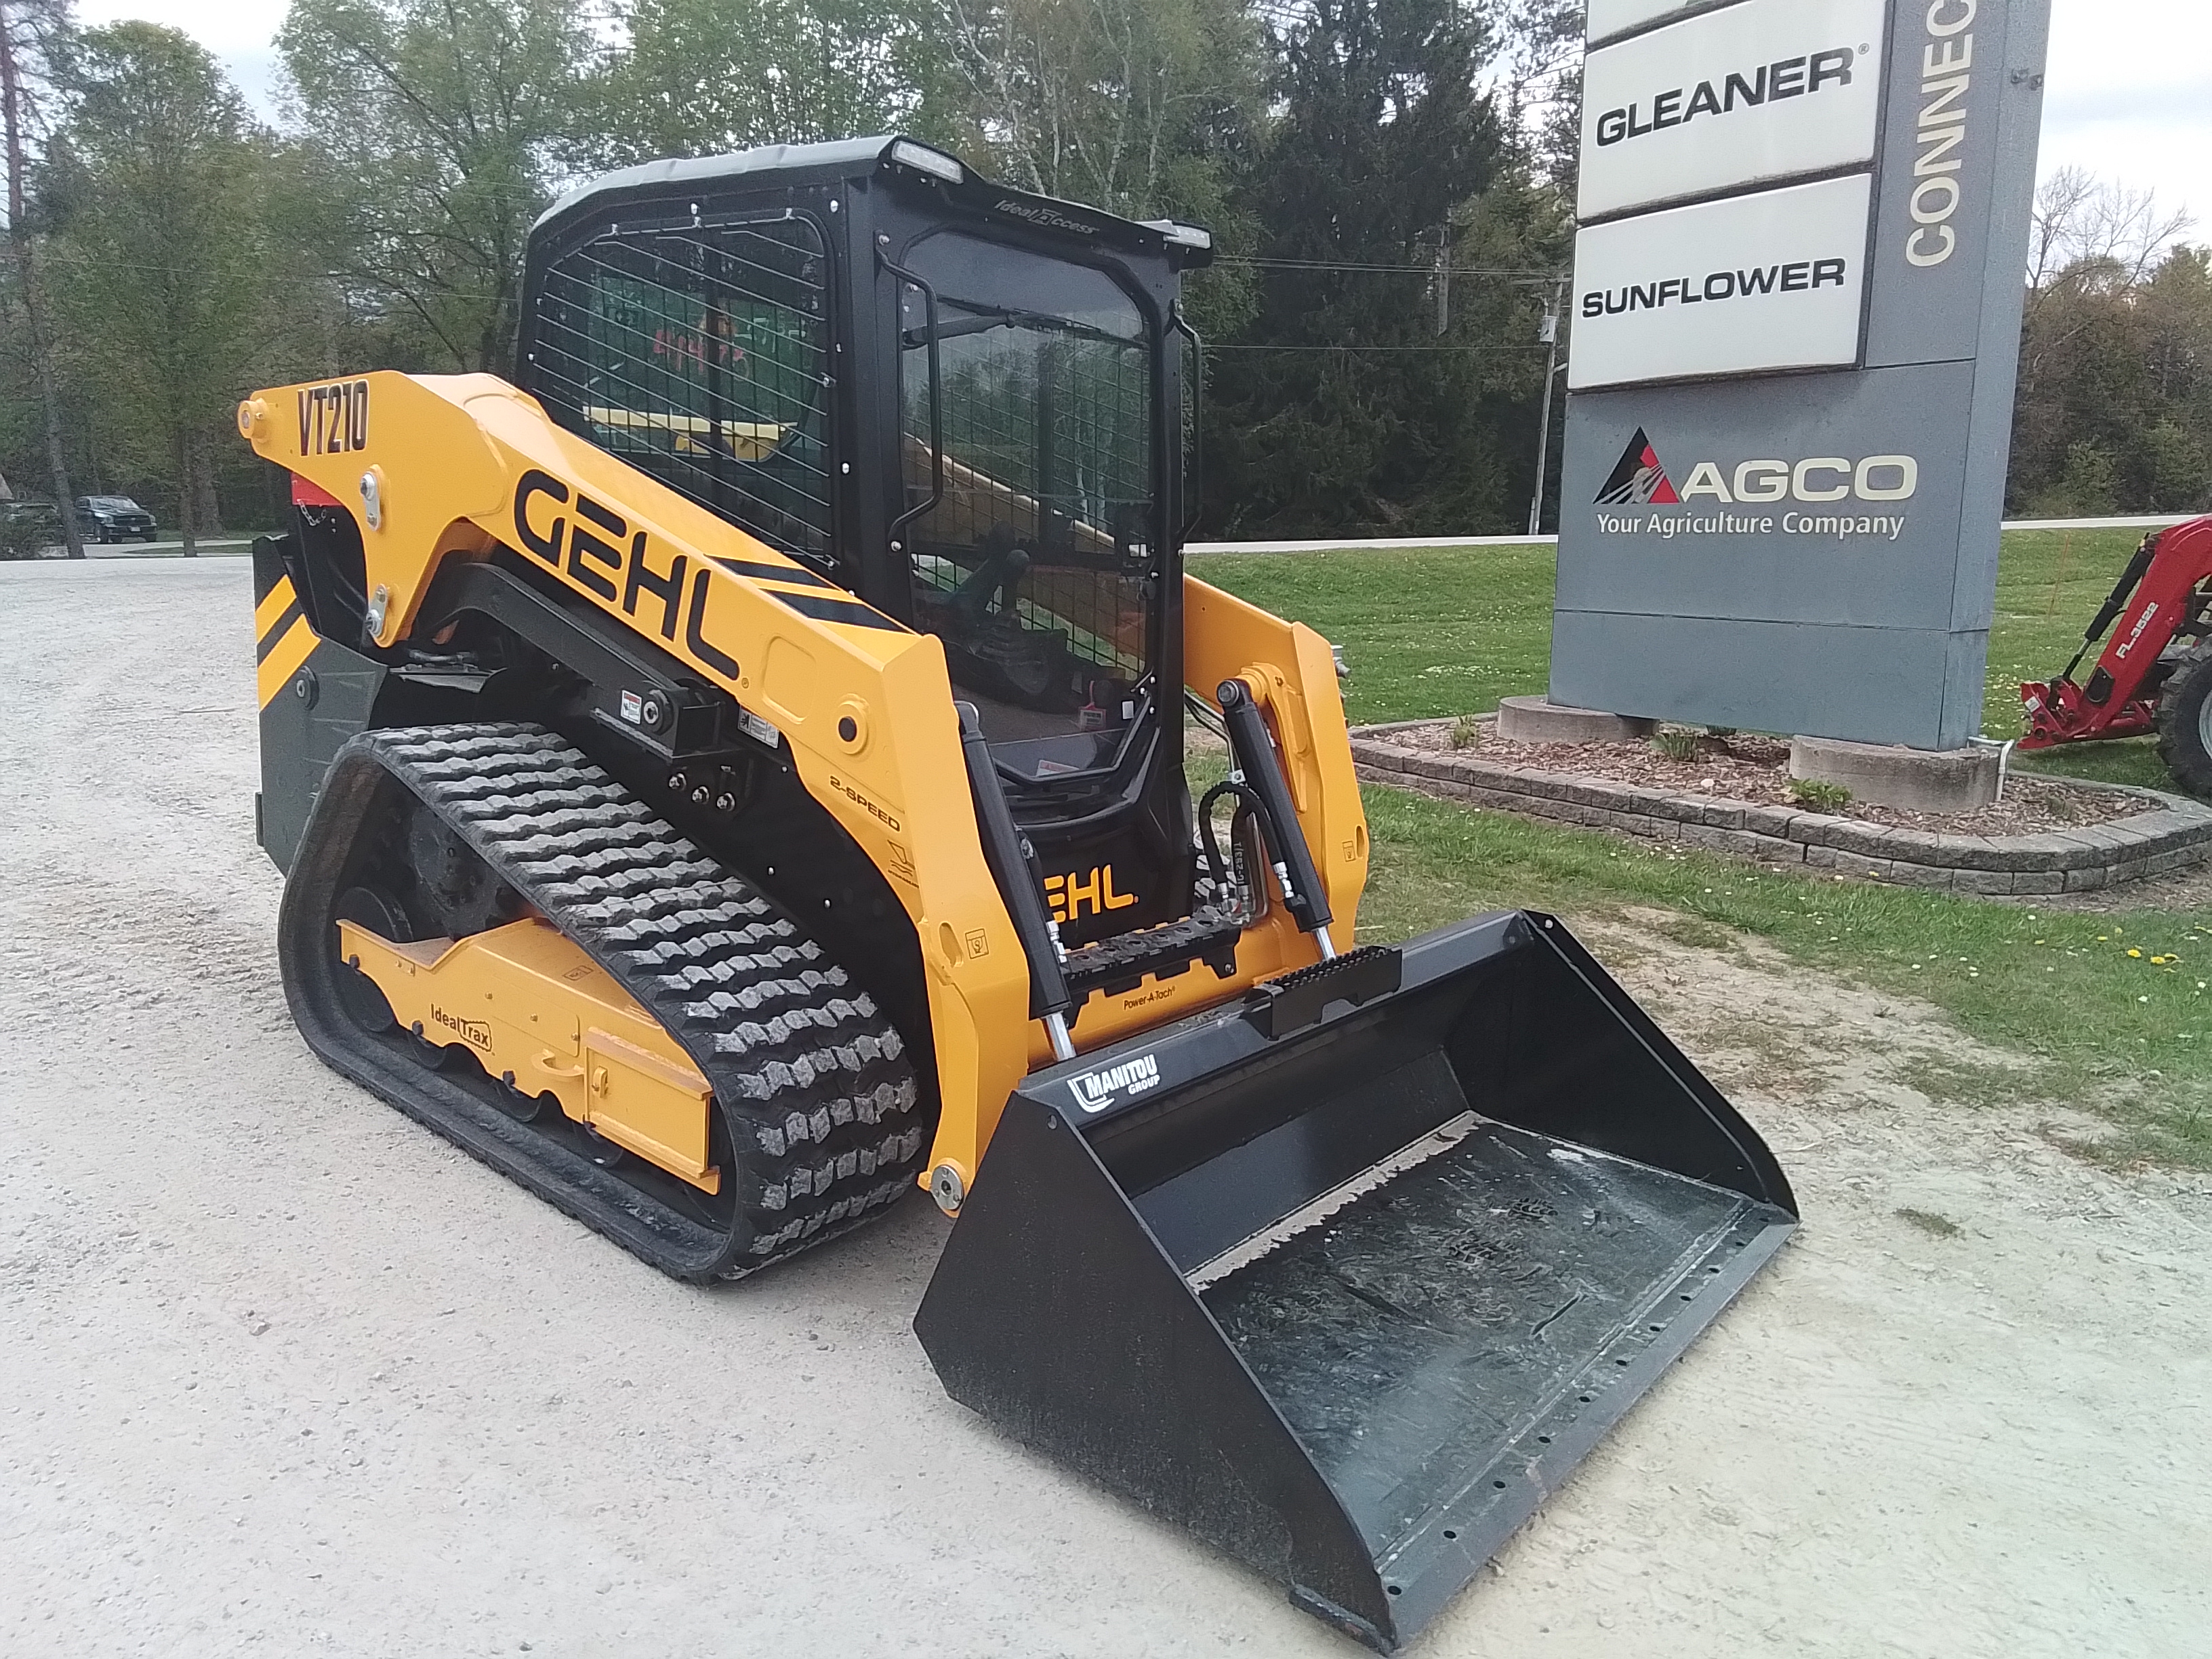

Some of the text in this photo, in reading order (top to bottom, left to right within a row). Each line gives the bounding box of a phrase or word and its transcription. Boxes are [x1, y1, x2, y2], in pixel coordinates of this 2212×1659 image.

[1582, 258, 1846, 318] SUNFLOWER
[298, 379, 369, 457] VT210
[1681, 455, 1918, 503] AGCO
[1597, 511, 1905, 540] Your Agriculture Company
[514, 468, 741, 681] GEHL
[830, 775, 901, 833] 2-SPEED
[1044, 863, 1134, 924] EHL
[430, 1002, 491, 1050] IdealTrax
[1084, 1054, 1158, 1099] MANITOU
[1128, 1074, 1160, 1095] GROUP
